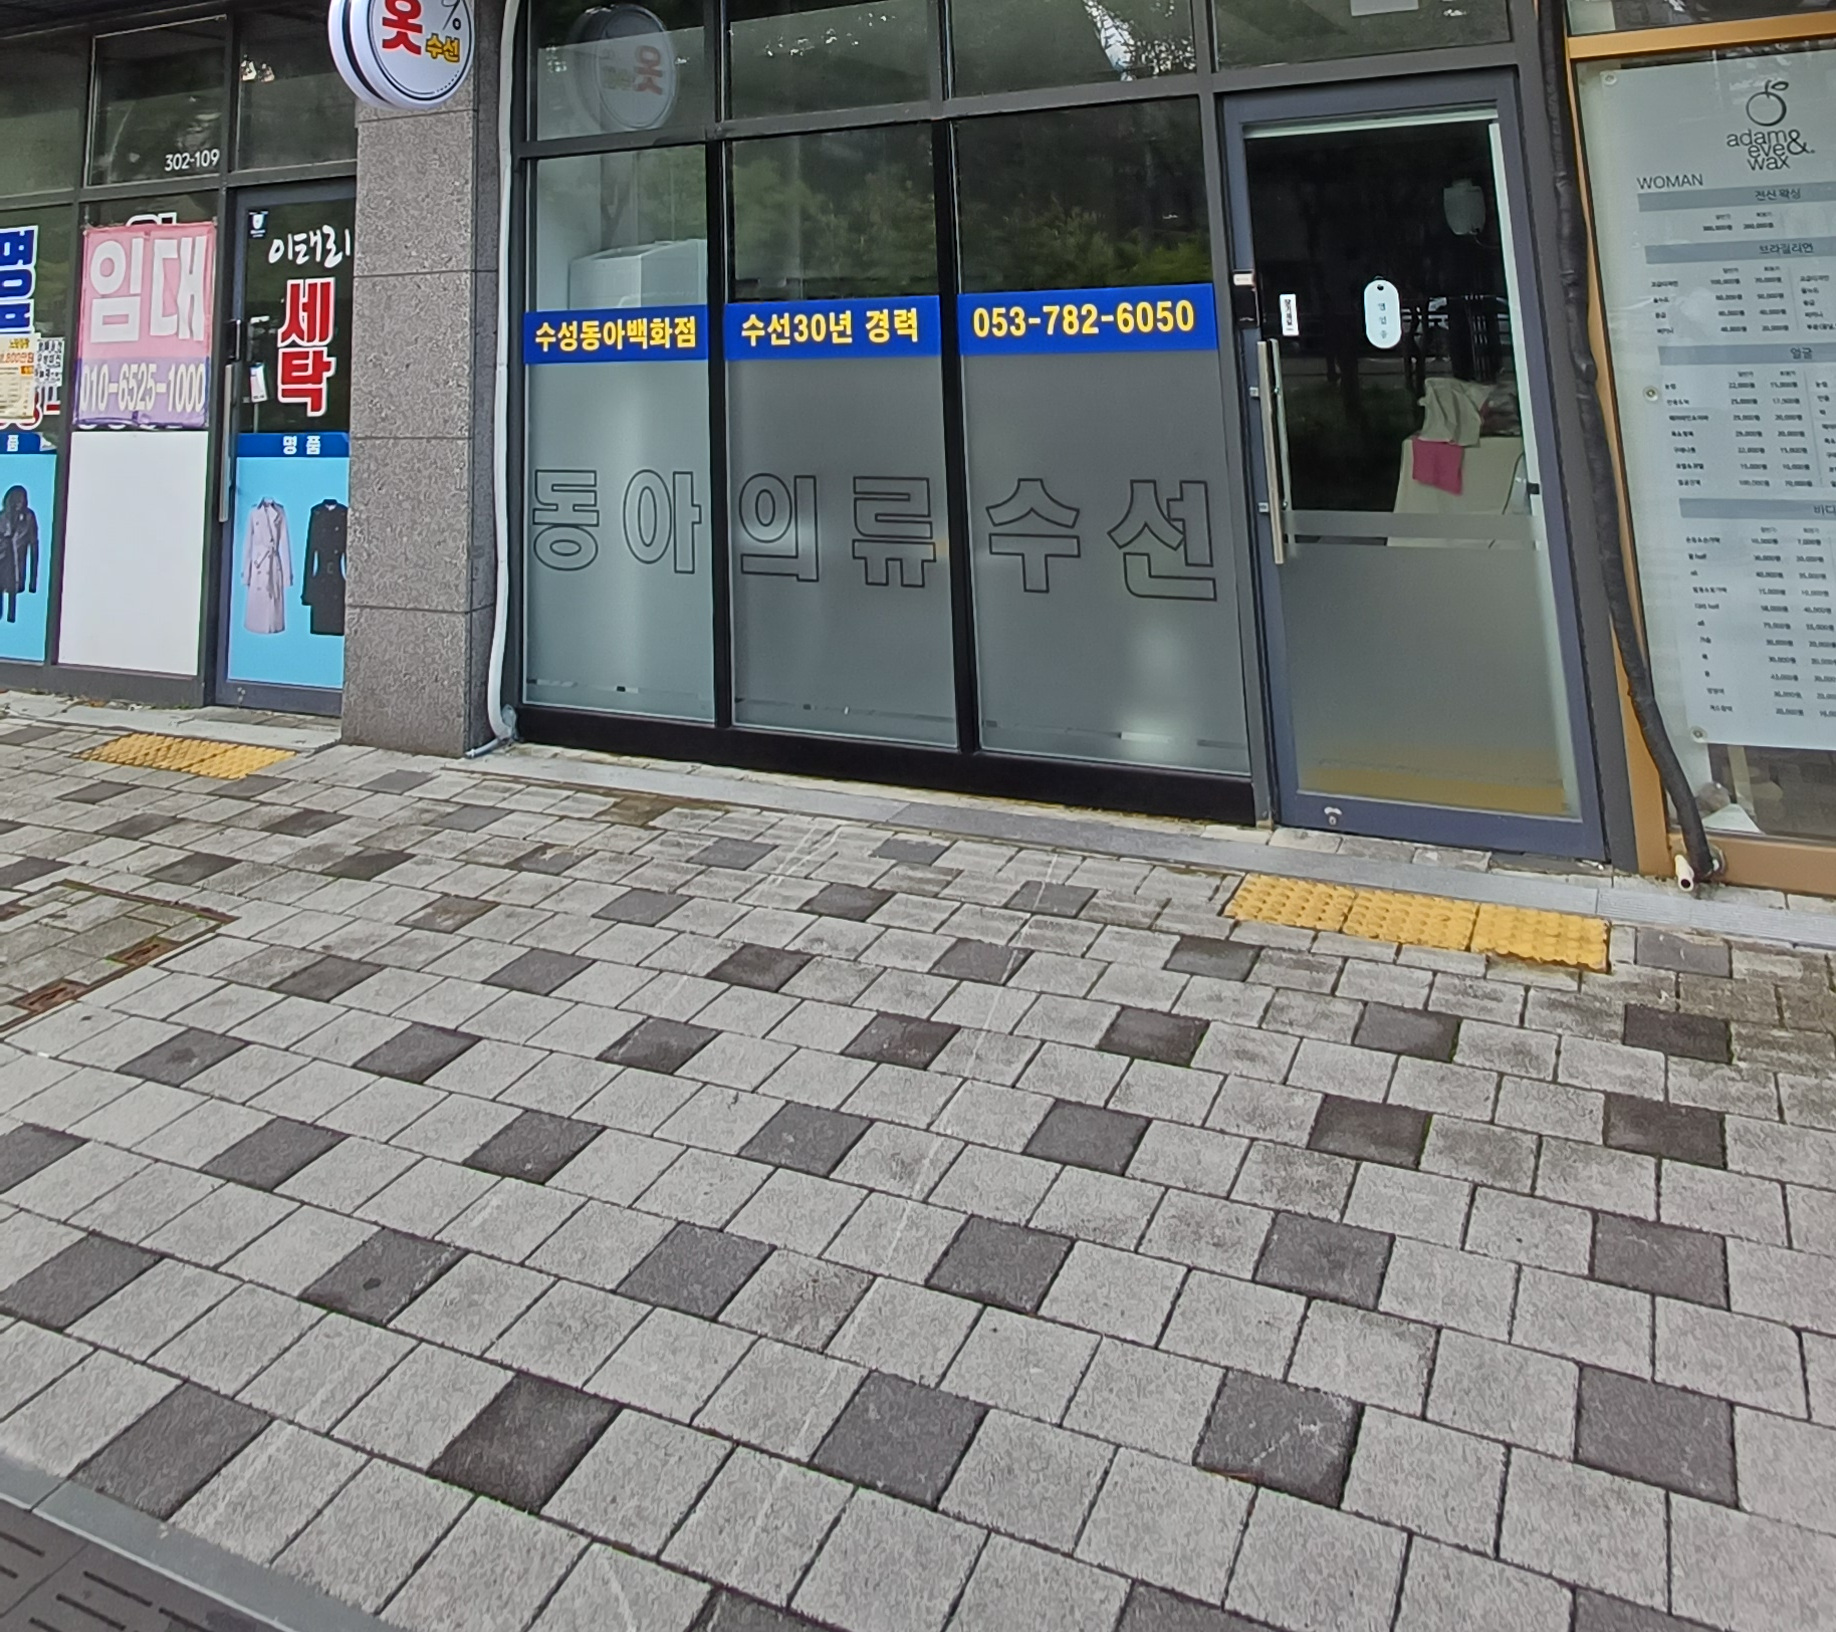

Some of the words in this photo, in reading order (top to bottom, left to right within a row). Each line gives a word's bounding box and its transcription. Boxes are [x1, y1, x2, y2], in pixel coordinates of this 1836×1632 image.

[425, 32, 460, 62] 수선
[164, 149, 220, 171] 302-109
[1747, 155, 1791, 171] wax
[1636, 174, 1704, 190] WOMAN
[90, 235, 207, 344] 임대
[534, 313, 698, 351] 수성동아백화점
[741, 311, 853, 347] 수선30년
[865, 307, 920, 344] 경력
[973, 299, 1195, 338] 053-782-6050
[78, 361, 206, 414] 010-6525-1000
